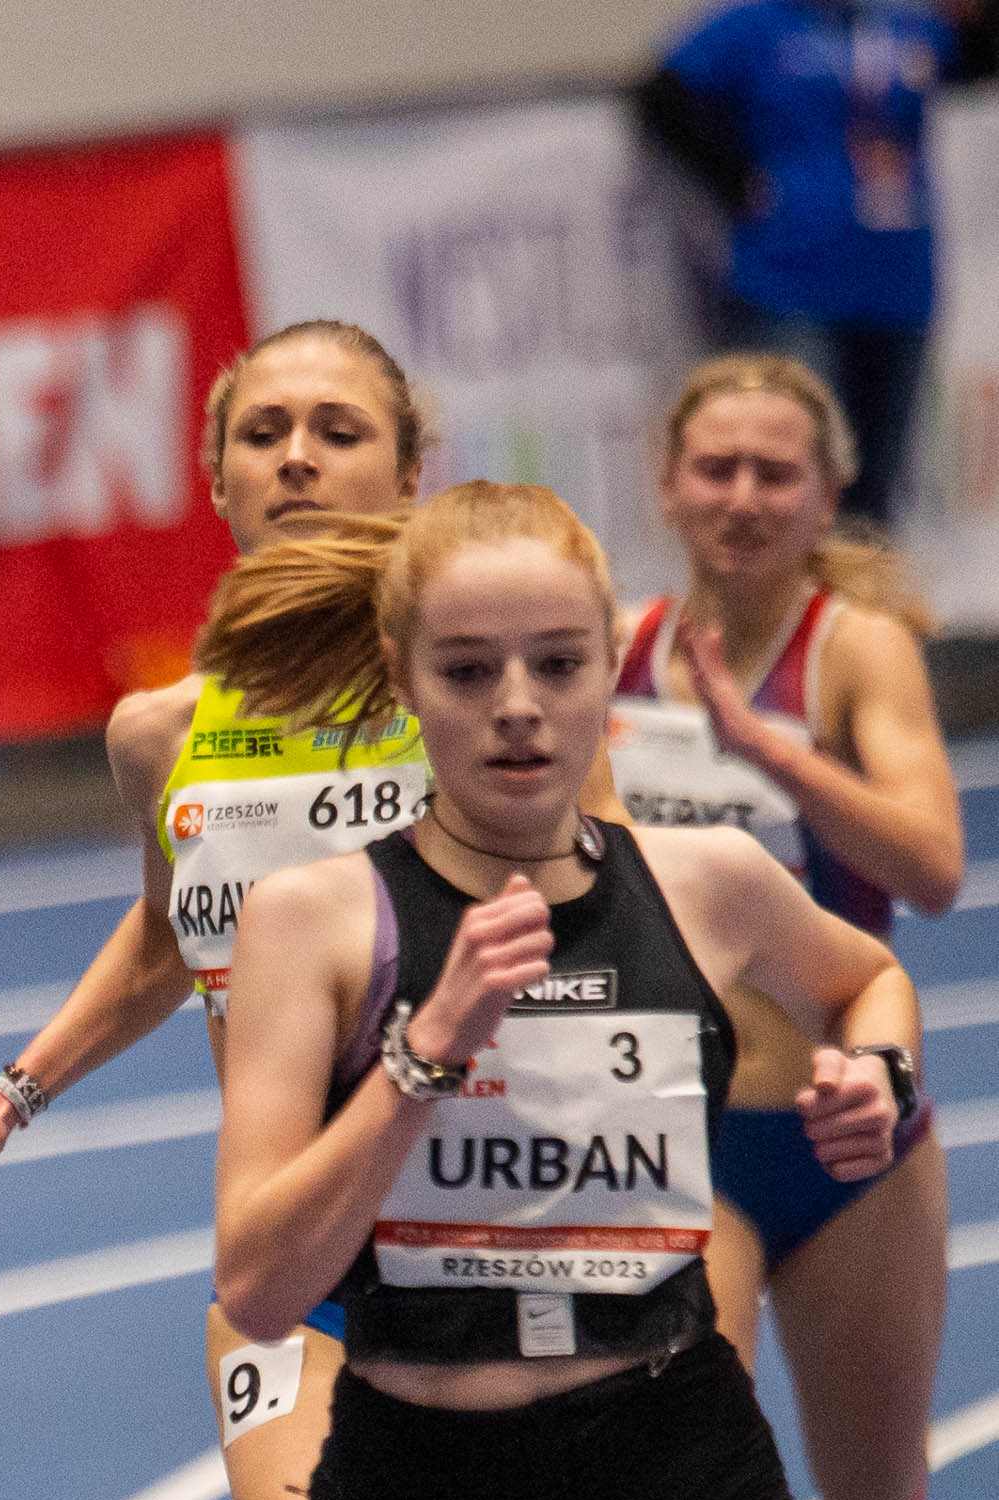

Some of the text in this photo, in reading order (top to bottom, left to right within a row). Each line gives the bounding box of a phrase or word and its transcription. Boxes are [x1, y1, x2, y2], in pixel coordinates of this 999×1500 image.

[207, 801, 279, 821] rzeszów
[309, 781, 401, 830] 618
[609, 1031, 642, 1084] 3
[428, 1133, 669, 1194] URBAN
[441, 1254, 648, 1279] RZESZÓW 2023
